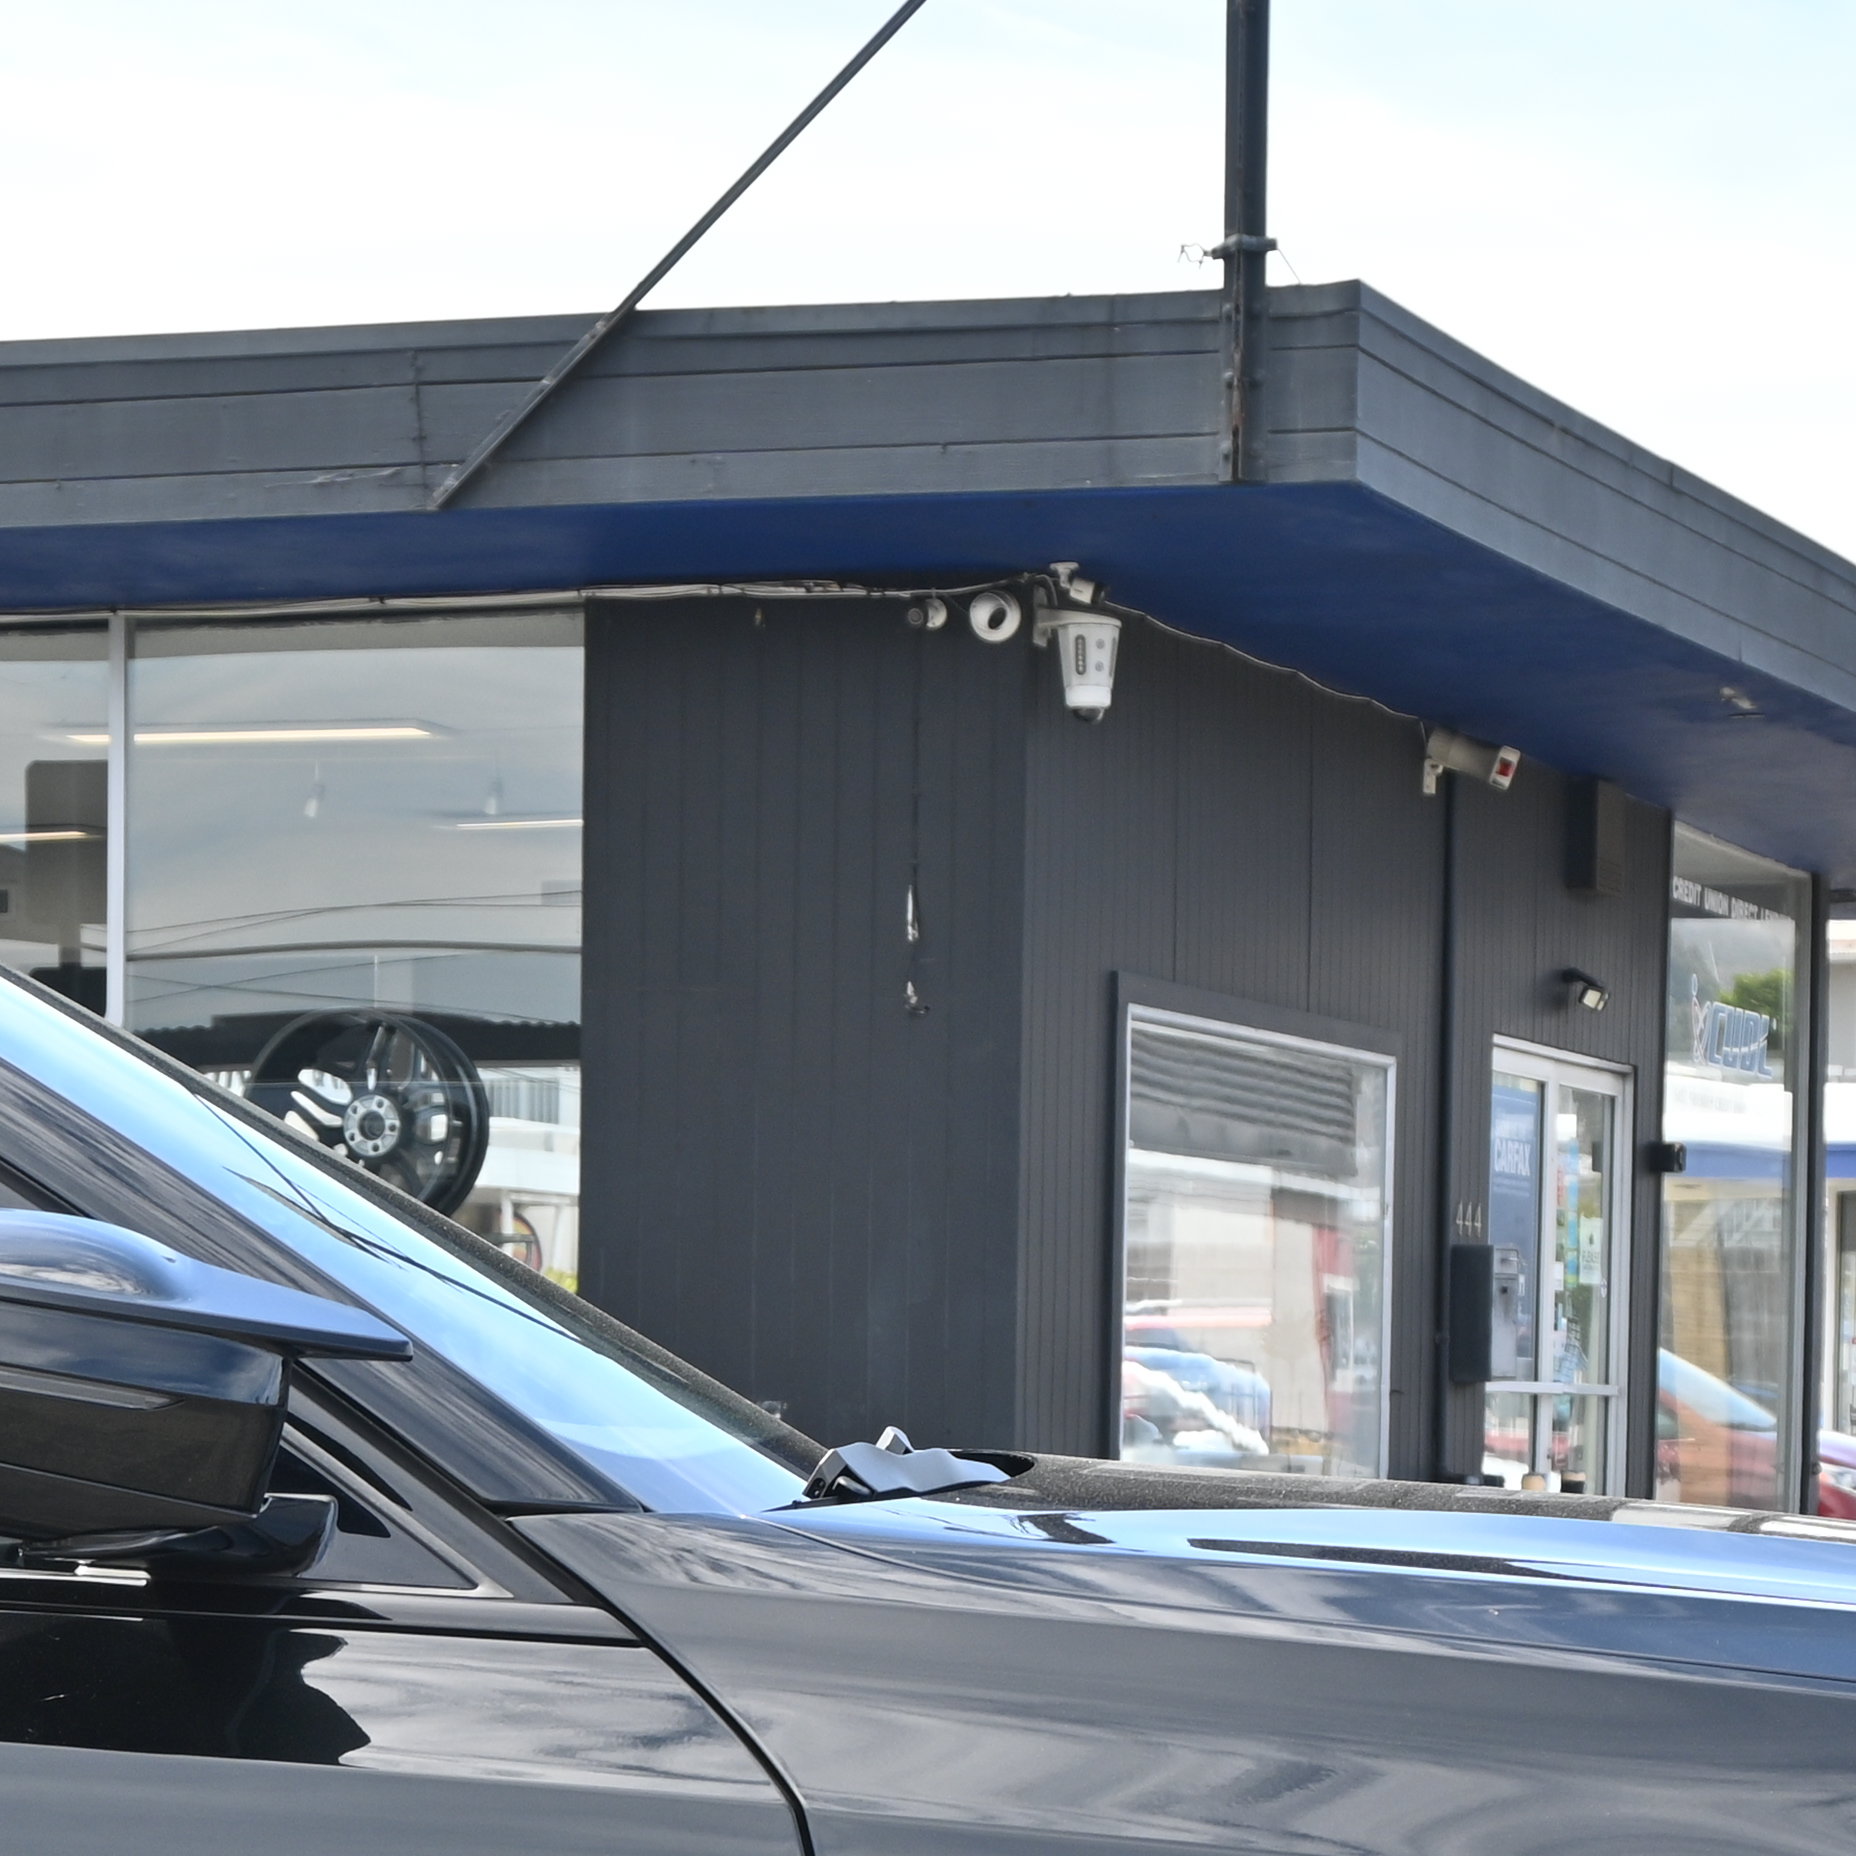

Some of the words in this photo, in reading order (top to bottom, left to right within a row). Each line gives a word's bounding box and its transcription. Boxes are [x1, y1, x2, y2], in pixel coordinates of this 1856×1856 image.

[1673, 875, 1702, 908] CREDIT
[1704, 885, 1729, 917] UNION
[1494, 1136, 1532, 1177] CARFAX
[1456, 1200, 1482, 1239] 444
